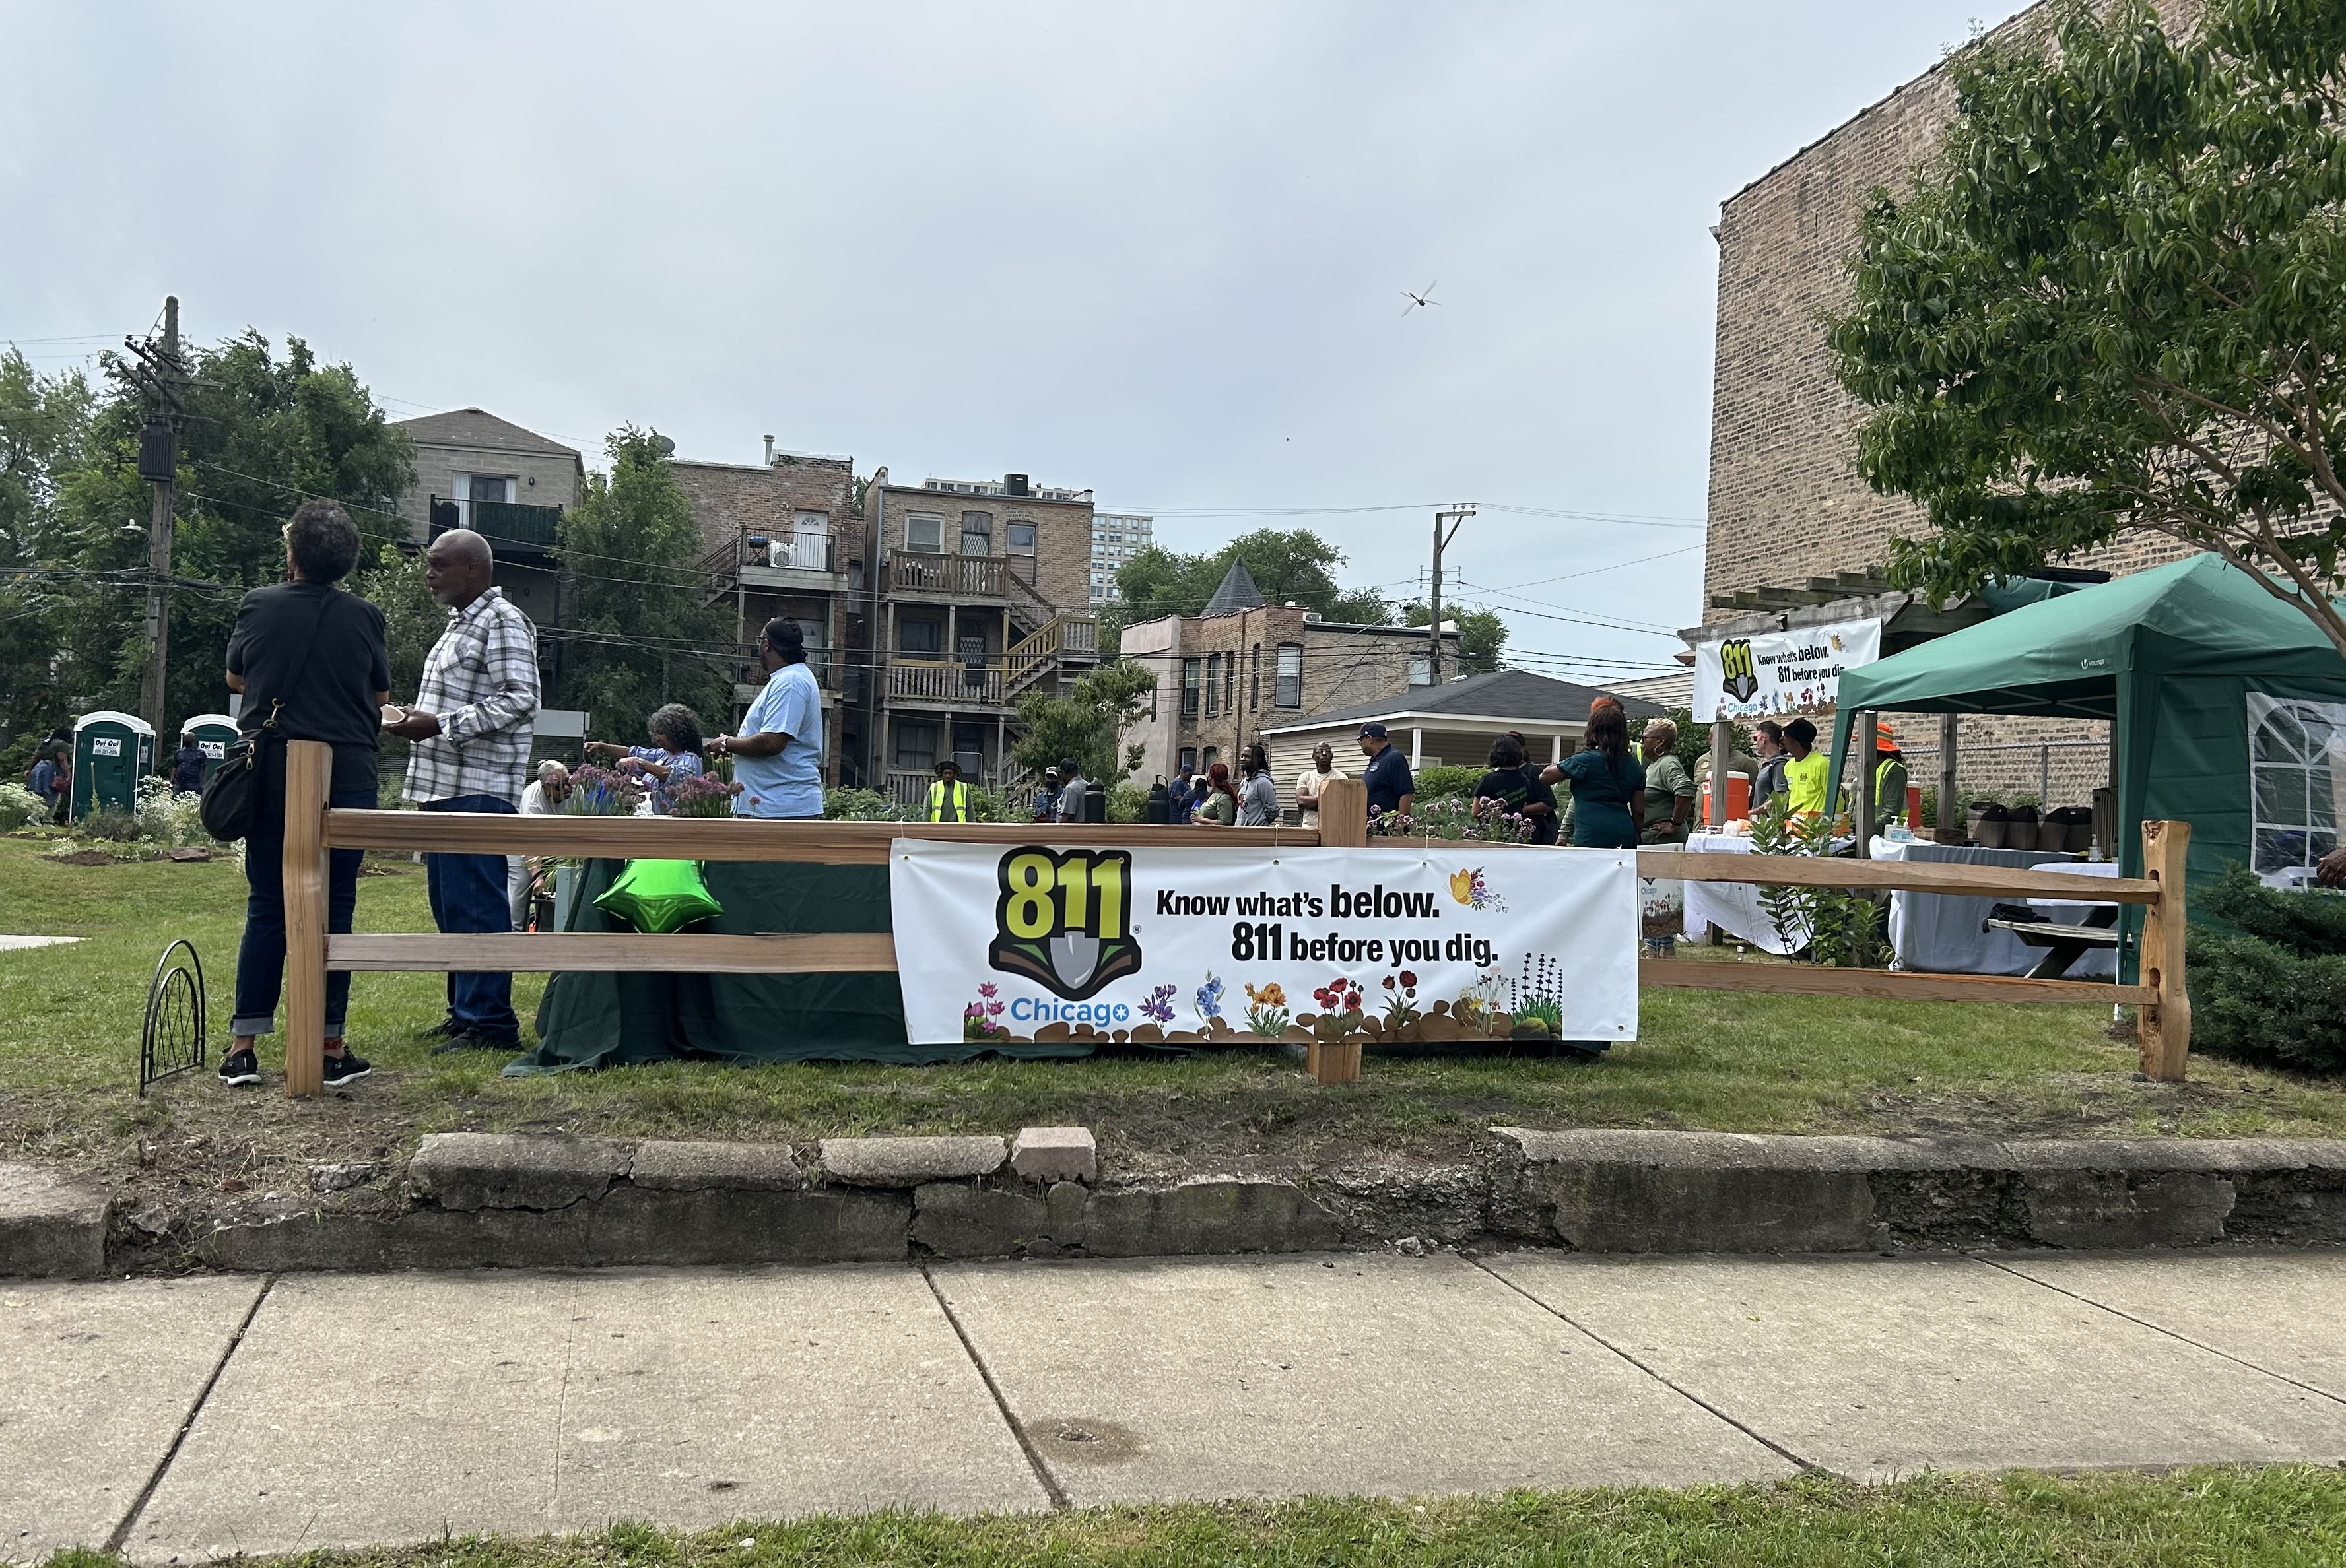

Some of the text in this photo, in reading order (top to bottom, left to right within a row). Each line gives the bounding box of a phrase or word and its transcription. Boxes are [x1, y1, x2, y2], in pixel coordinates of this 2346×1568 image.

[1722, 643, 1753, 679] 811
[1757, 644, 1829, 666] Know what's below.
[1778, 665, 1791, 683] 811
[1792, 667, 1817, 682] before
[1819, 667, 1830, 682] you
[1727, 702, 1757, 713] Chicago
[1006, 853, 1122, 939] 811
[1156, 884, 1440, 918] Know what's below.
[1232, 921, 1498, 967] 811 before you dig.
[1011, 997, 1129, 1027] Chicago
